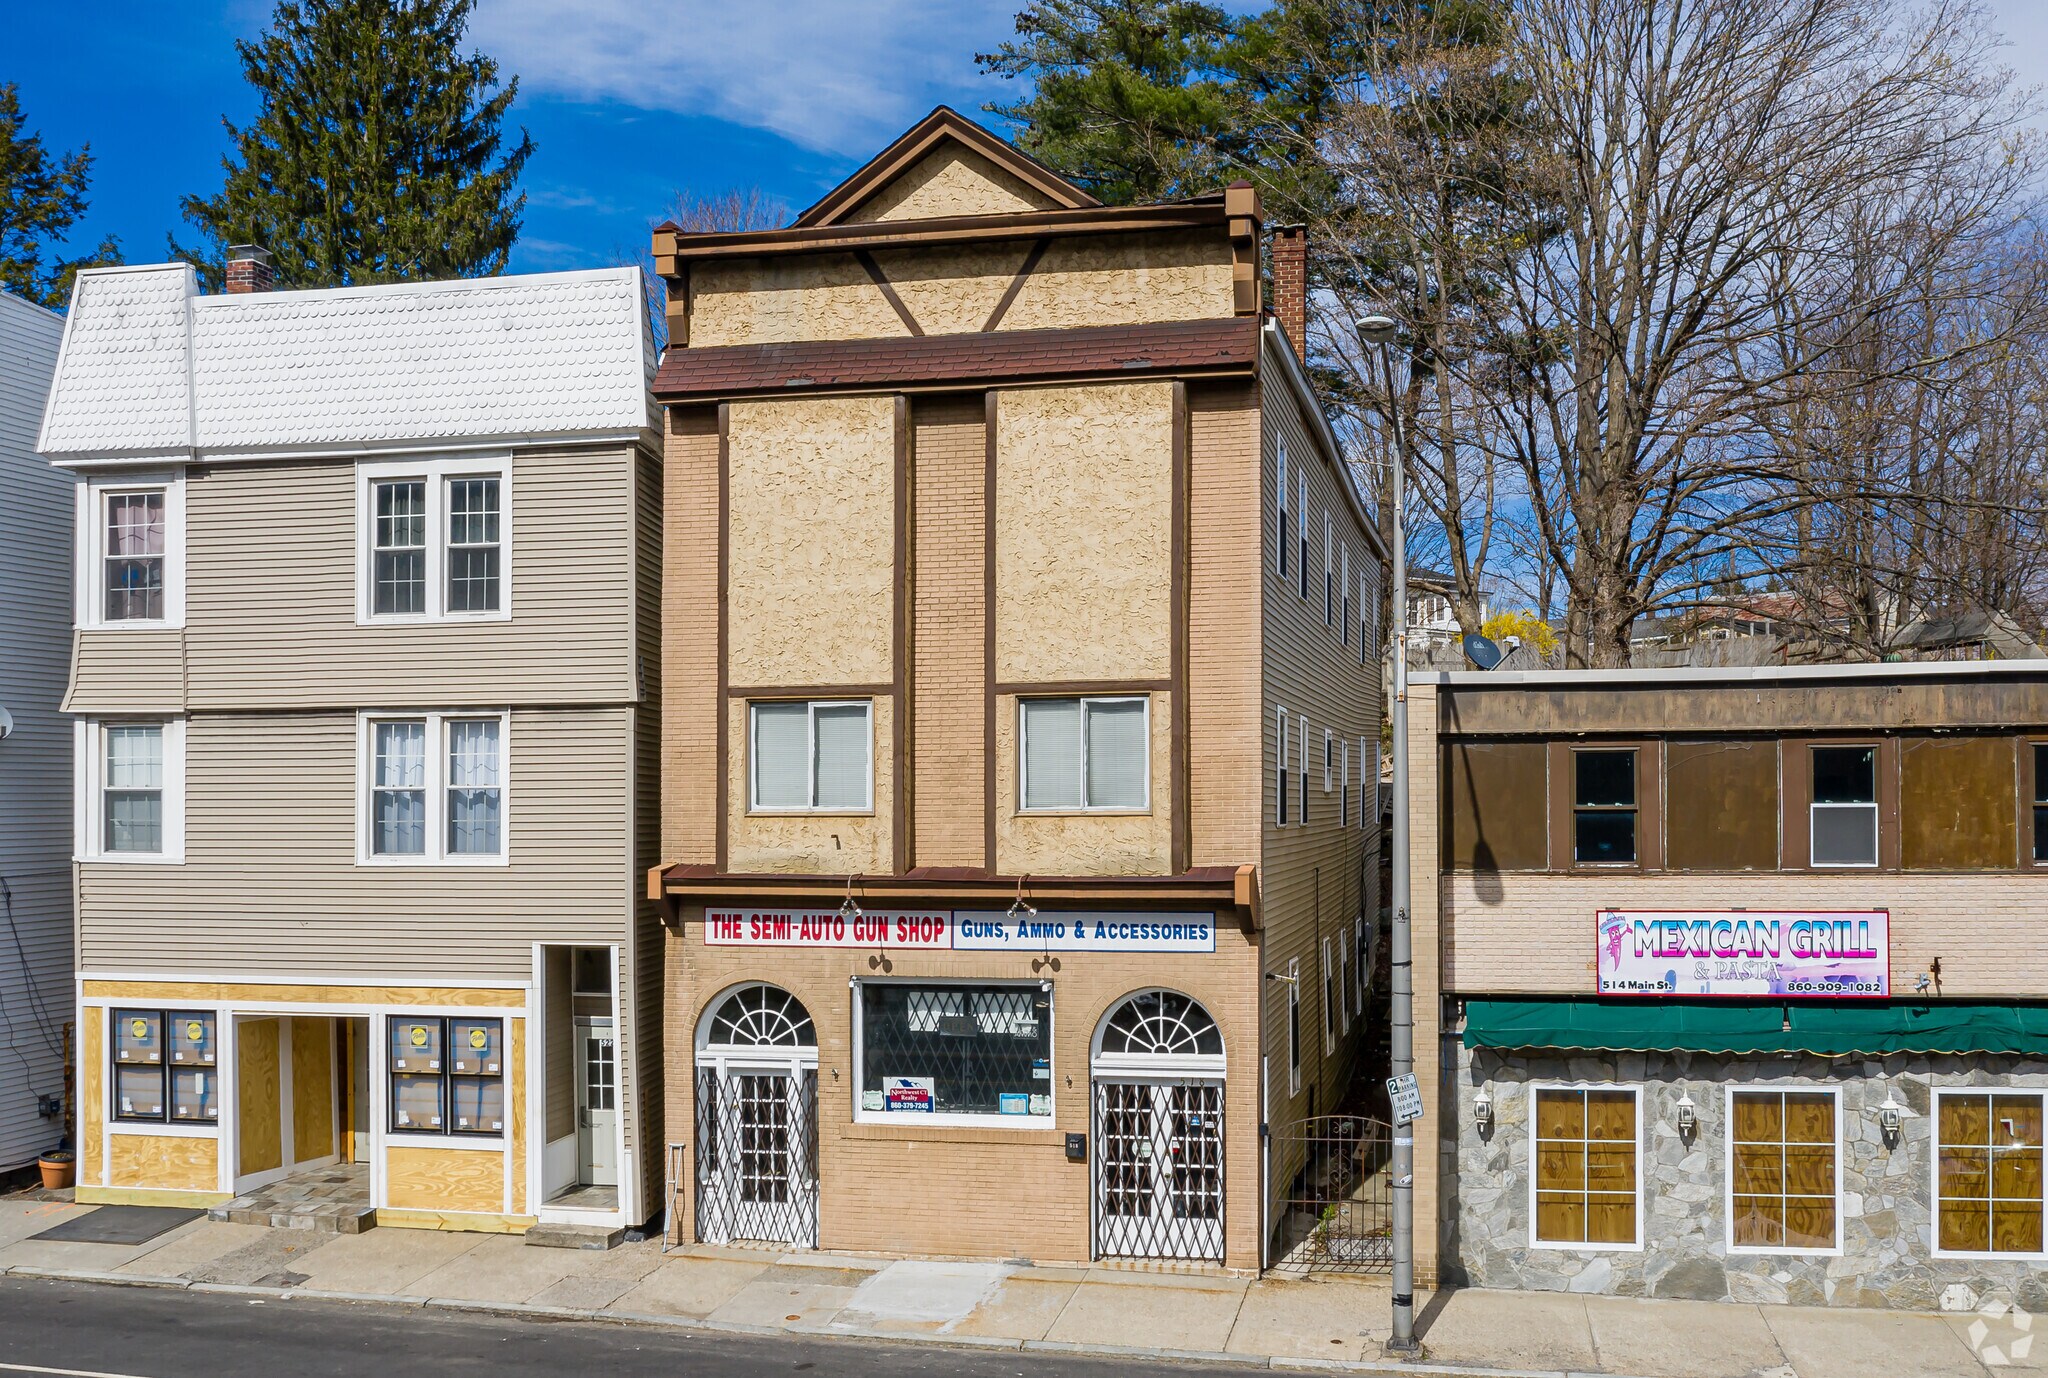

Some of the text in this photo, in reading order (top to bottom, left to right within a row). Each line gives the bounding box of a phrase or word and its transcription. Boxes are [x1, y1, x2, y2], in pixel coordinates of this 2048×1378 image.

[711, 914, 945, 943] THE SEMI-AUTO GUN SHOP
[961, 919, 1209, 942] GUNS, AMMO & ACCESSORIES
[1634, 919, 1877, 959] MEXICAN GRILL
[1693, 960, 1782, 981] & PASTA
[1602, 980, 1673, 989] 514 Main St.
[1787, 982, 1881, 992] 860-909-1082
[1389, 1081, 1398, 1094] 2
